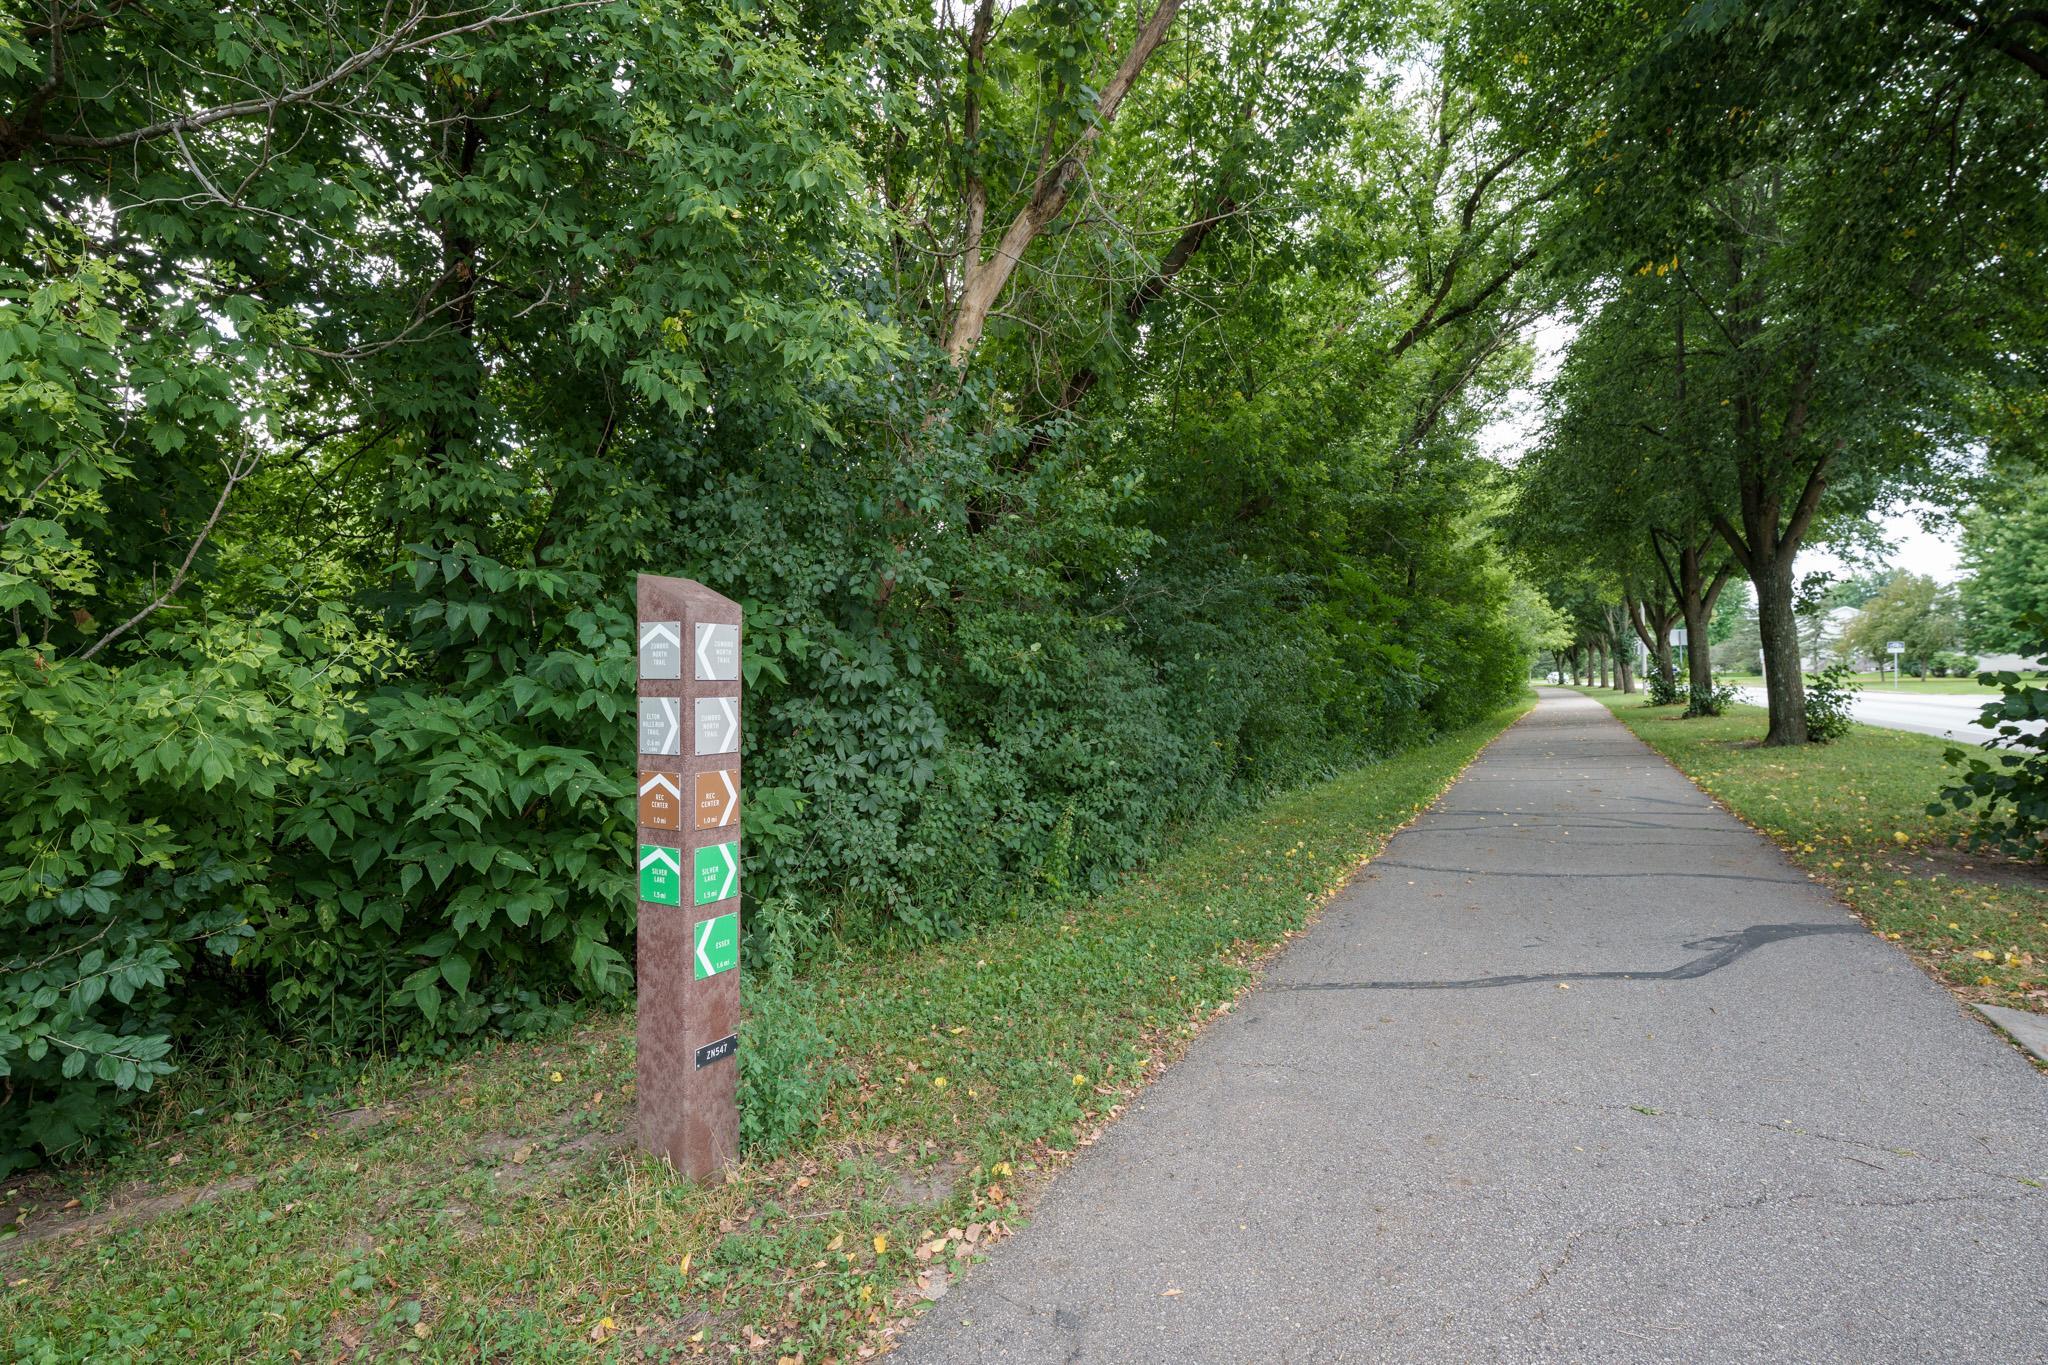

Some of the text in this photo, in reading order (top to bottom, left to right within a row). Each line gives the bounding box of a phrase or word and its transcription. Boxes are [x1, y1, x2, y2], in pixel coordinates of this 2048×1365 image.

[655, 793, 664, 801] REC
[651, 801, 668, 809] CENTER
[701, 800, 719, 808] CENTER
[651, 868, 668, 876] SILVER
[702, 865, 719, 876] SILVER
[653, 876, 665, 884] LAKE
[704, 874, 716, 883] LAKE
[706, 1043, 728, 1060] ZN547
